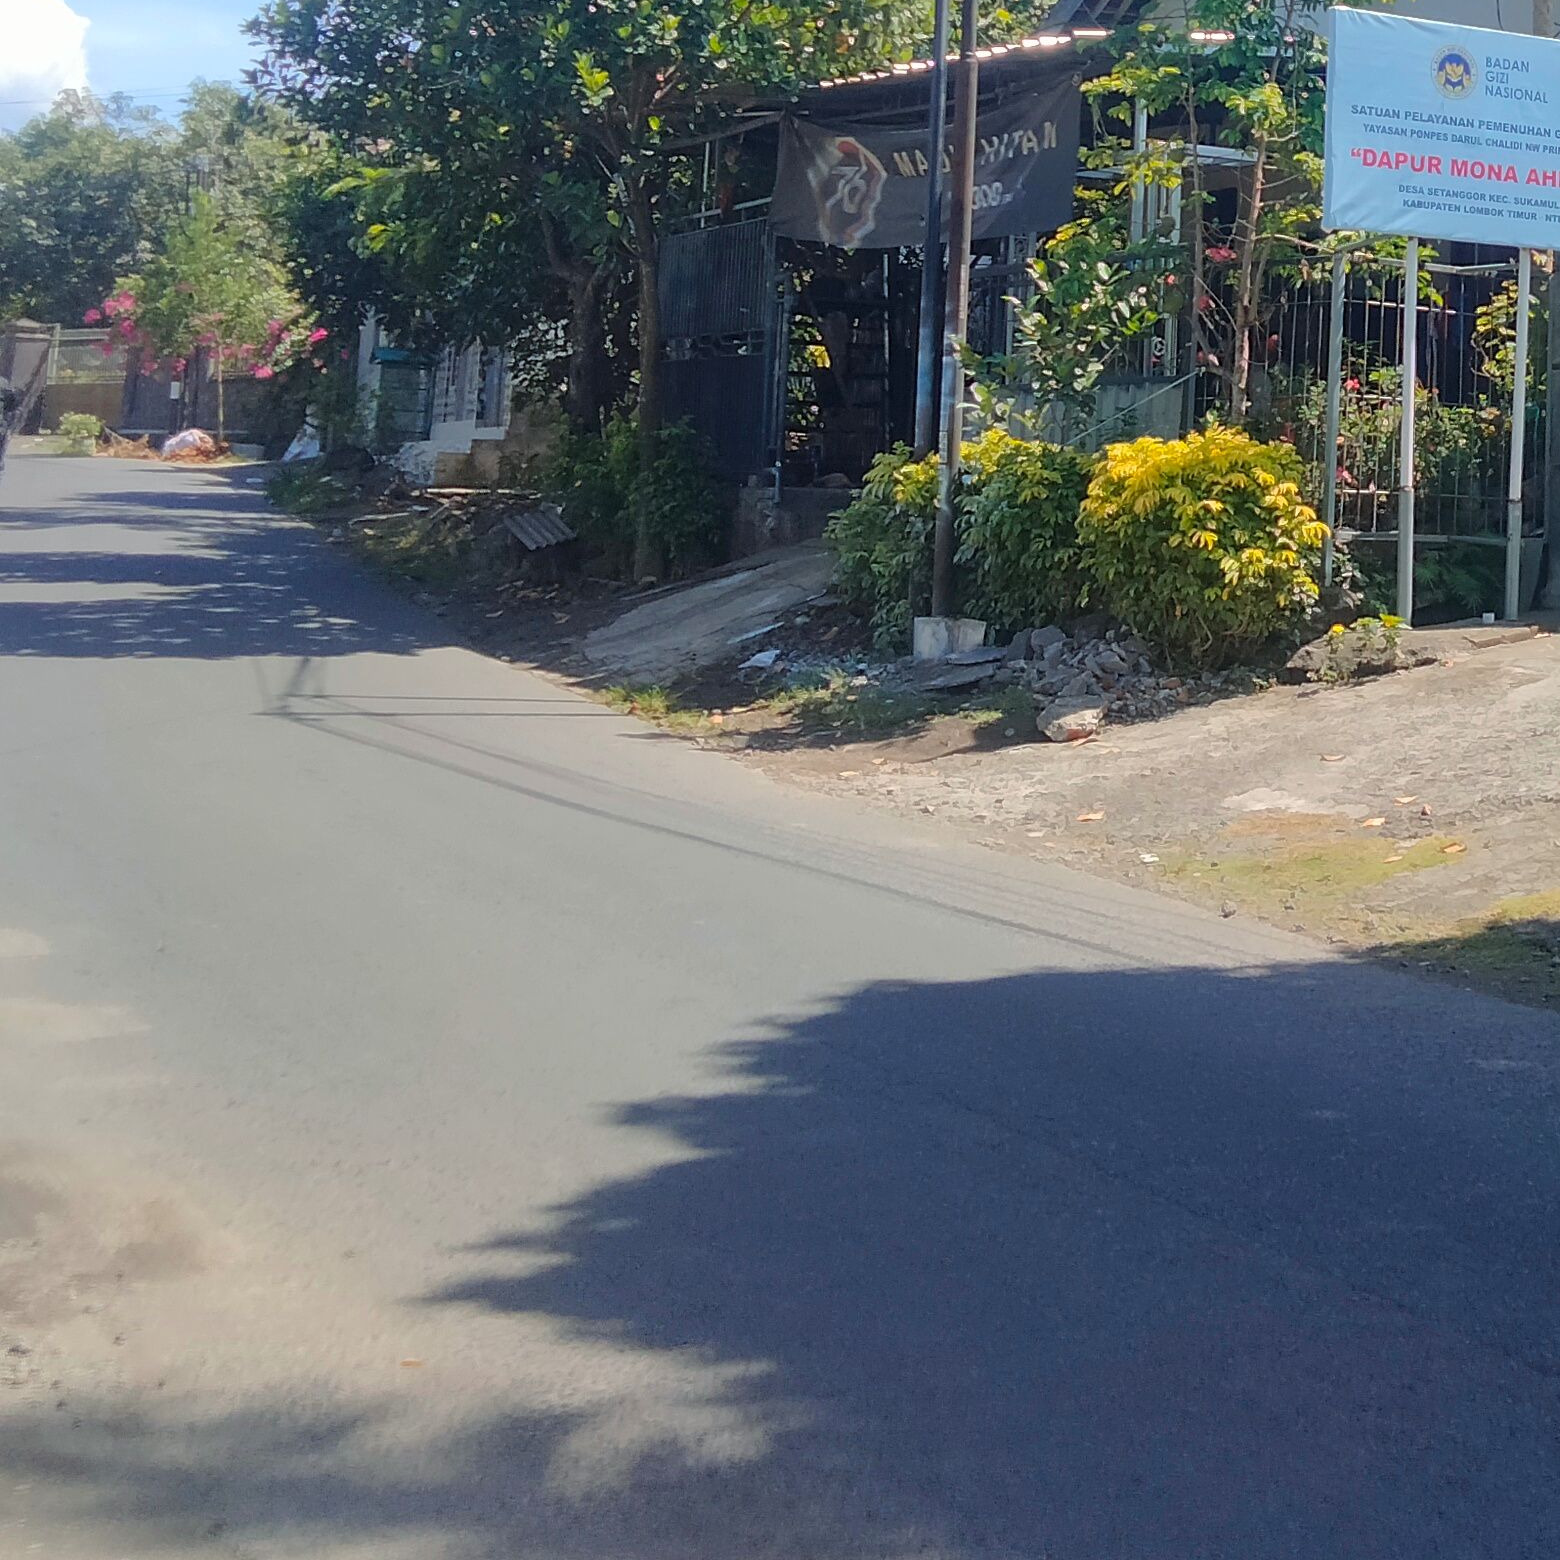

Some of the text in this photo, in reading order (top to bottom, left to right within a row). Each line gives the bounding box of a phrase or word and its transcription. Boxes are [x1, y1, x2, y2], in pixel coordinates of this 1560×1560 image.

[1485, 56, 1530, 72] BADAN
[1485, 70, 1509, 85] GIZI
[1485, 85, 1549, 104] NASIONAL
[1350, 104, 1401, 120] SATUAN
[1404, 110, 1474, 129] PELAYANAN
[1477, 119, 1552, 139] PEMENUHAN
[1362, 122, 1408, 137] YAYASAN
[1410, 128, 1449, 142] PONPES
[1451, 133, 1483, 146] DARUL
[1485, 137, 1523, 151] CHALIDI
[1525, 142, 1541, 153] NW
[1450, 158, 1519, 184] MONA
[1398, 184, 1425, 196] DESA
[1427, 187, 1487, 203] SETANGGOR
[1488, 194, 1512, 205] KEC.
[1402, 198, 1461, 213] KABUPATEN
[1463, 205, 1505, 218] LOMBOK
[1506, 210, 1538, 222] TIMUR
